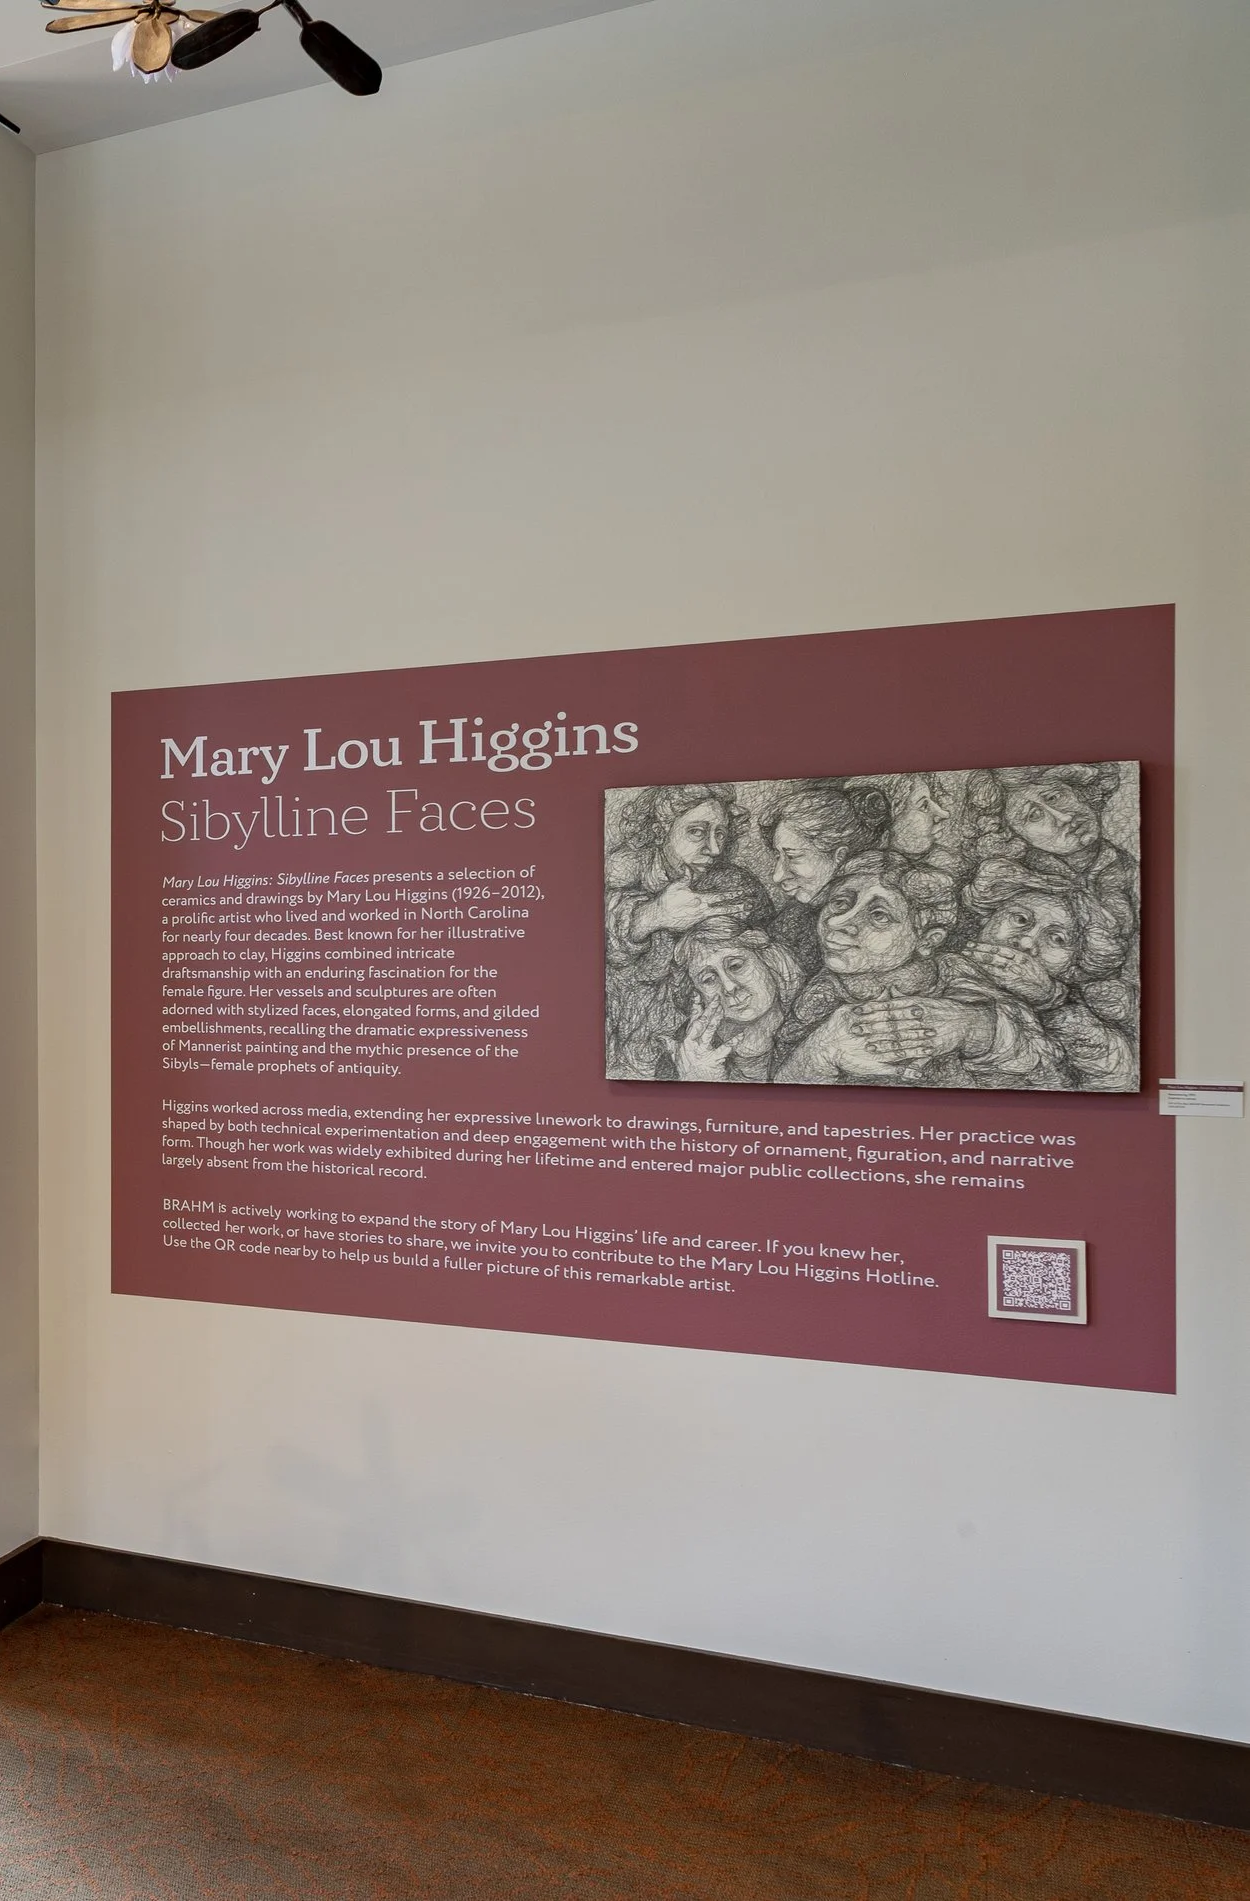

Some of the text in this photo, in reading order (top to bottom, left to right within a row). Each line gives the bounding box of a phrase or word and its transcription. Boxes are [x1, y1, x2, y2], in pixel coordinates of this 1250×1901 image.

[160, 711, 638, 785] Mary Lou Higgins
[161, 788, 535, 850] Sibylline Faces
[162, 864, 536, 890] Mary Lou Higgins: Sibylline Faces presents a selection of
[161, 894, 216, 906] ceramics
[219, 892, 242, 905] and
[245, 892, 303, 907] drawings
[307, 890, 323, 906] by
[327, 890, 361, 905] Mary
[365, 889, 390, 902] Lou
[395, 888, 448, 904] Higgins
[161, 905, 529, 927] a prolific artist who lived and worked in North Carolina
[162, 925, 525, 945] for nearly four decades. Best known for her illustrative
[162, 946, 455, 963] approach to clay, Higgins combined intricate
[162, 965, 497, 982] draftsmanship with an enduring fascination for the
[162, 984, 496, 1000] female figure. Her vessels and sculptures are often
[162, 1002, 539, 1021] adorned with stylized faces, elongated forms, and gilded
[162, 1021, 528, 1040] embellishments, recalling the dramatic expressiveness
[162, 1038, 519, 1059] of Mannerist painting and the mythic presence of the
[257, 1059, 316, 1075] prophets
[320, 1060, 334, 1073] of
[337, 1062, 401, 1077] antiquity.
[162, 1099, 1076, 1146] Higgins worked across media, extending her expressive linework to drawings, furniture, and tapestries. Her practice was
[162, 1152, 427, 1178] largely absent from the historical record.
[163, 1198, 214, 1213] BRAHM
[218, 1202, 226, 1213] is
[231, 1204, 281, 1220] actively
[286, 1207, 338, 1225] working
[341, 1211, 355, 1223] to
[359, 1214, 409, 1227] expand
[413, 1215, 437, 1229] the
[440, 1218, 477, 1234] story
[480, 1219, 496, 1233] of
[500, 1220, 538, 1239] Mary
[542, 1223, 570, 1238] Lou
[642, 1230, 668, 1245] life
[671, 1234, 701, 1248] and
[706, 1239, 761, 1252] career.
[766, 1239, 780, 1253] If
[782, 1244, 814, 1257] you
[819, 1243, 866, 1260] knew
[870, 1246, 904, 1265] her,
[162, 1217, 939, 1287] collected her work, or have stories to share, we invite you to contribute to the Mary Lou Higgins Hotline.
